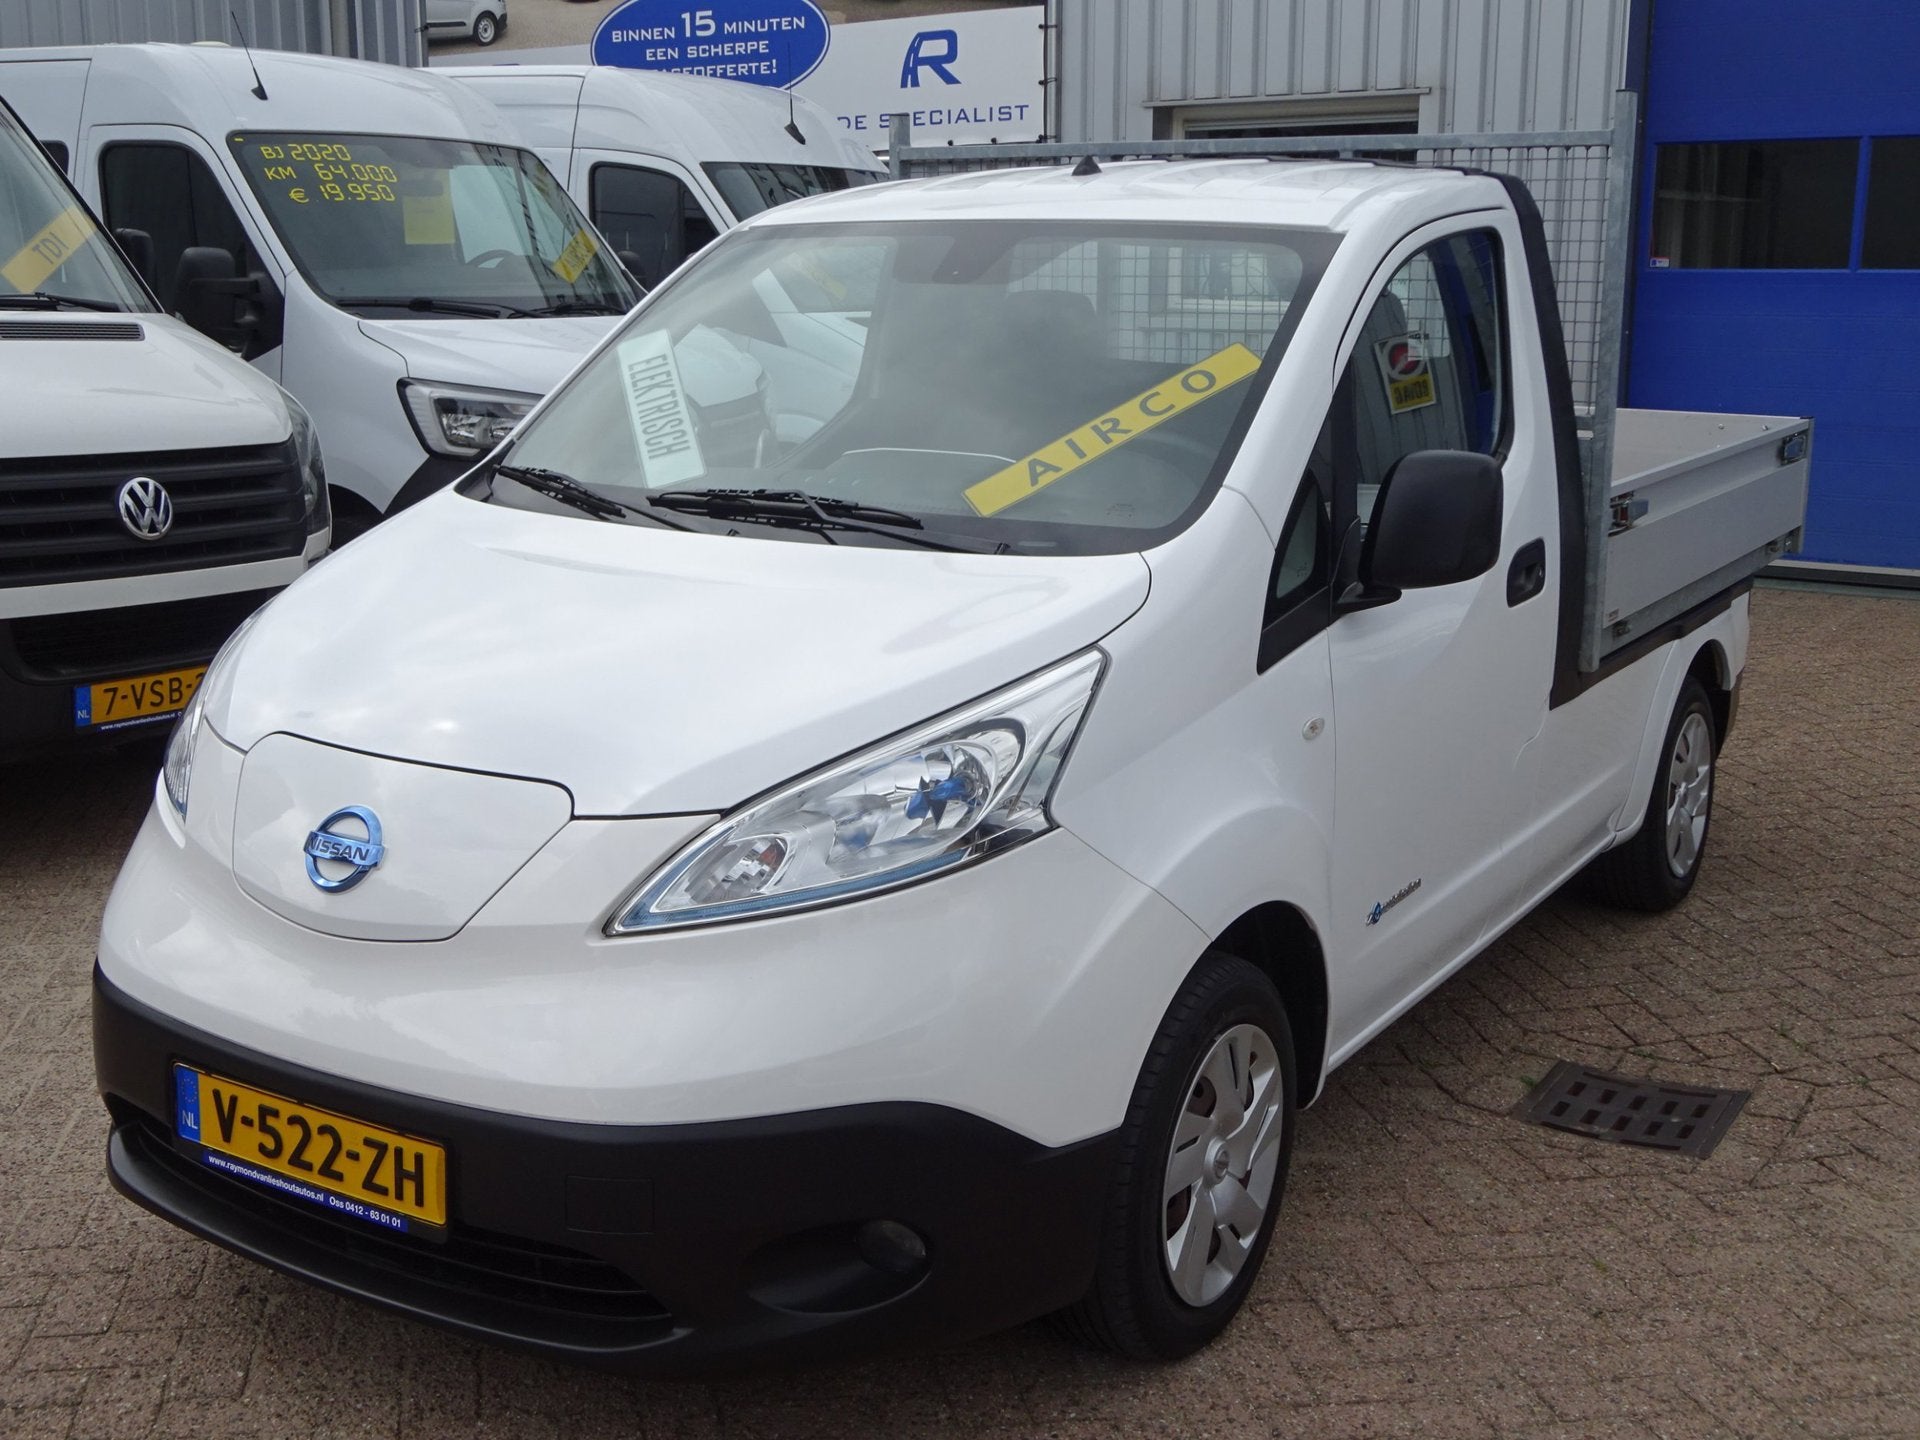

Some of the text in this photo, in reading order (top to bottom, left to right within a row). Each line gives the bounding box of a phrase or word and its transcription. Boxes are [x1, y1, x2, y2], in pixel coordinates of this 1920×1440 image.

[612, 10, 805, 42] BINNEN 15 MINUTEN
[646, 40, 769, 61] EEN SCHERPE
[879, 104, 1029, 129] SECIALIST
[260, 143, 352, 160] BJ 2020
[264, 163, 398, 182] KM 64.000
[320, 183, 395, 201] 19.950
[32, 231, 69, 265] TDI
[628, 354, 691, 460] ELEKTRISCH
[1027, 369, 1217, 487] AIRCO
[103, 672, 206, 715] 7-VSB-
[77, 709, 90, 719] NL
[306, 838, 370, 861] NISSAN
[182, 1110, 198, 1130] NL
[212, 1088, 425, 1207] V-522-ZH
[208, 1155, 324, 1202] www.raymondvanlieshoutautos.nl
[329, 1196, 345, 1209] Oss
[345, 1201, 364, 1215] 0412
[370, 1209, 380, 1220] 63
[381, 1213, 390, 1224] 01
[391, 1217, 401, 1228] 01
